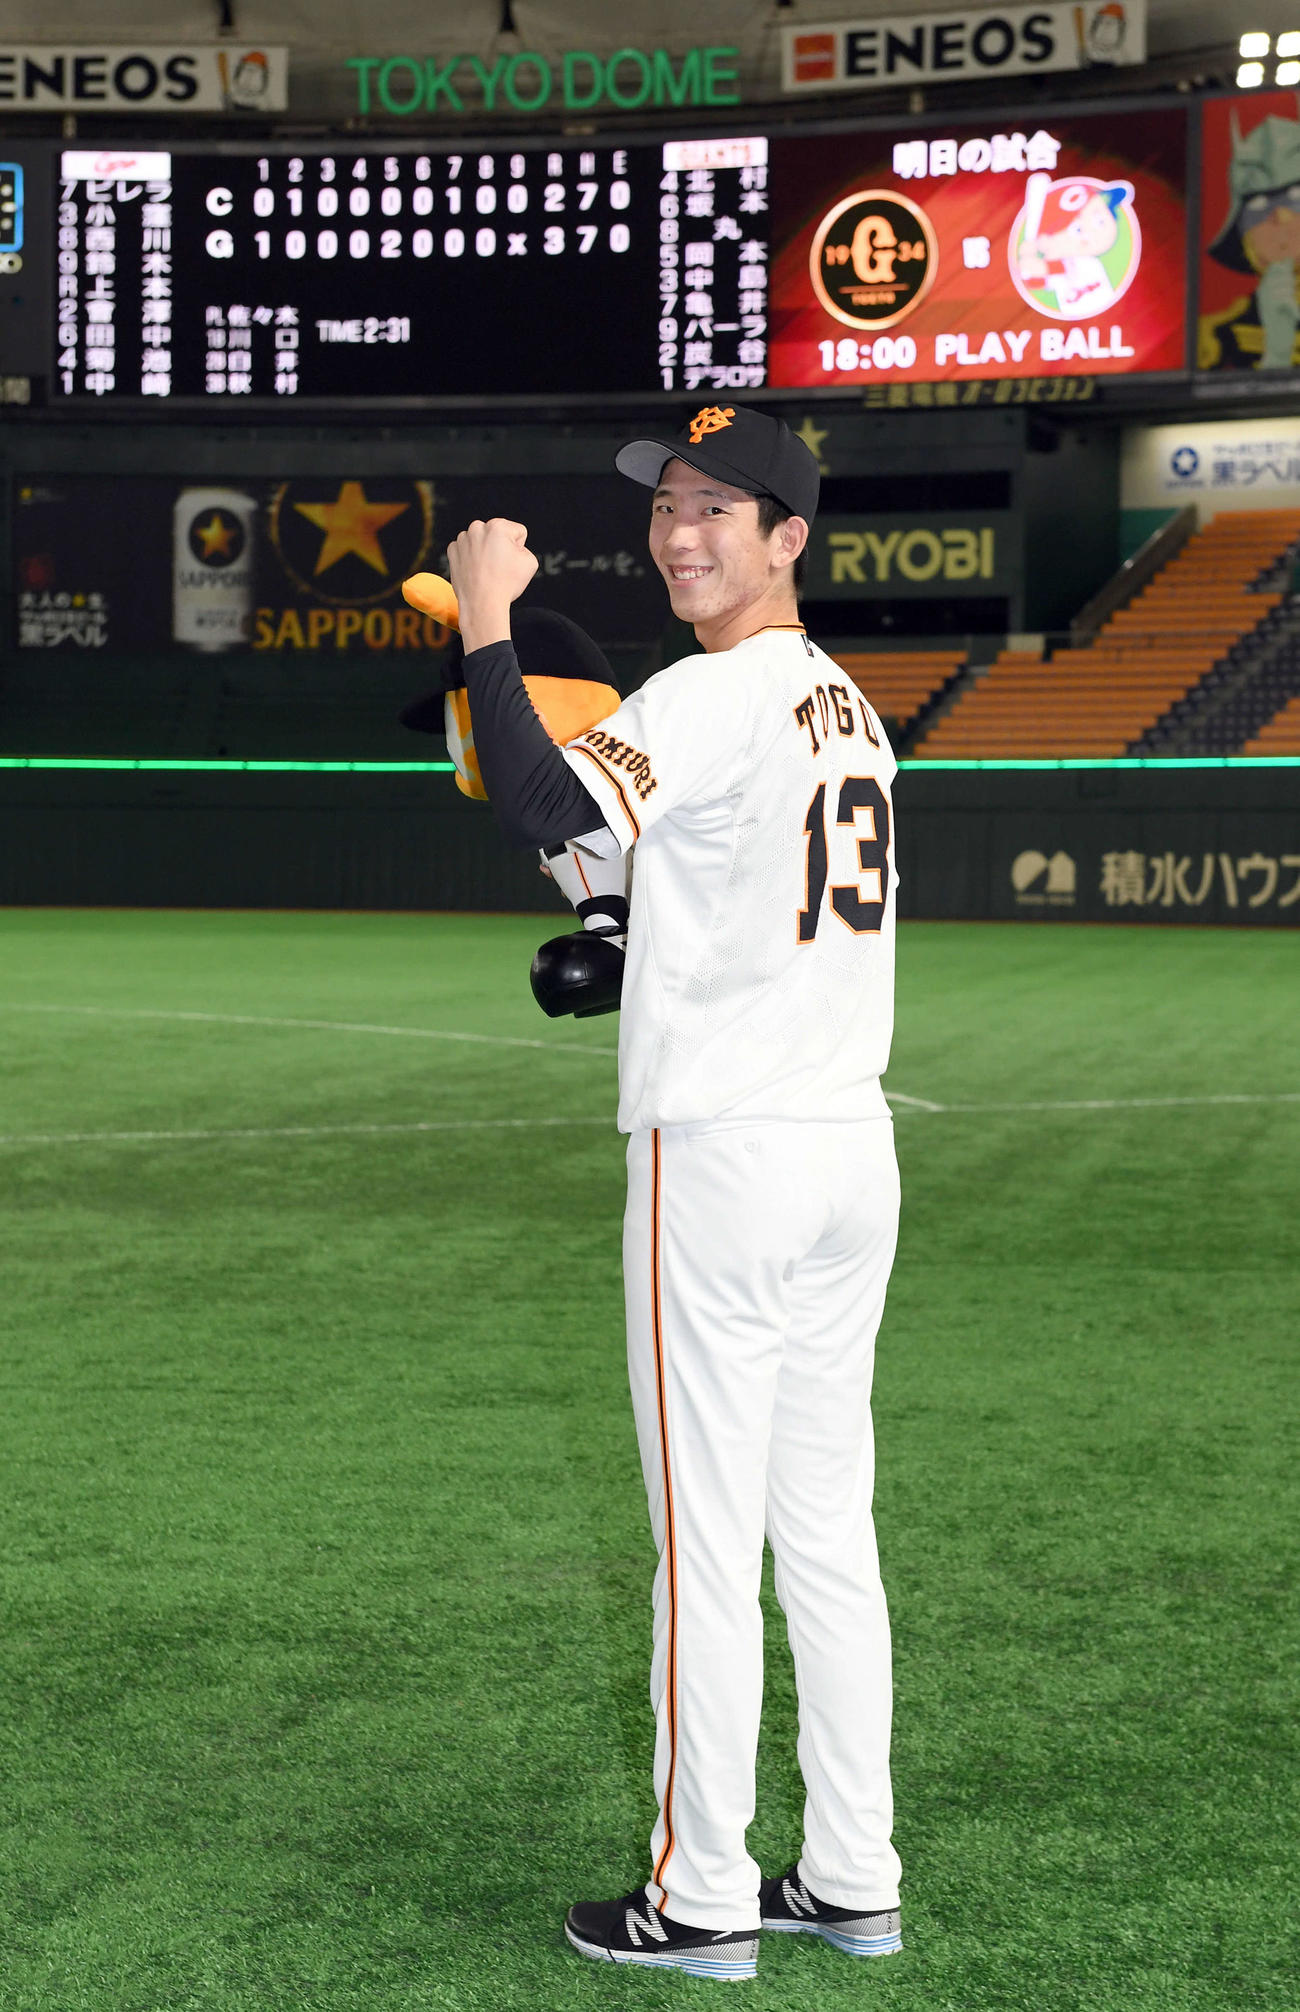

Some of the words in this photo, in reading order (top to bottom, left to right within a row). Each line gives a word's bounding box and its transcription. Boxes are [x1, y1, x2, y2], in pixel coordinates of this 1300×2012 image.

[845, 14, 1055, 78] ENEOS
[345, 52, 552, 115] TOKYO
[562, 46, 741, 108] DOME
[258, 158, 269, 182] 1
[288, 158, 304, 182] 2
[320, 158, 336, 182] 3
[352, 158, 368, 181] 4
[384, 157, 400, 181] 5
[416, 156, 431, 180] 6
[447, 156, 463, 180] 7
[612, 150, 628, 175] E
[893, 130, 1061, 179] 明日の試合
[60, 179, 78, 201] 7
[659, 171, 679, 193] 4
[206, 187, 233, 217] C
[254, 187, 275, 217] 0
[287, 188, 303, 217] 1
[317, 187, 339, 217] 0
[349, 187, 370, 217] 0
[381, 186, 402, 216] 0
[413, 186, 434, 216] 0
[445, 186, 461, 215] 1
[476, 185, 497, 215] 0
[507, 184, 528, 214] 0
[544, 183, 566, 212] 2
[576, 182, 598, 211] 7
[609, 181, 631, 210] 0
[660, 194, 680, 219] 6
[59, 201, 78, 226] 3
[255, 230, 271, 259] 1
[285, 230, 307, 260] 0
[317, 229, 339, 260] 0
[349, 229, 370, 259] 0
[381, 229, 402, 259] 2
[413, 229, 434, 259] 0
[445, 228, 465, 258] 0
[476, 227, 497, 257] 0
[544, 225, 566, 255] 3
[576, 225, 598, 254] 7
[609, 223, 631, 253] 0
[852, 215, 898, 284] G
[660, 244, 679, 268] 5
[659, 268, 678, 292] 3
[59, 298, 78, 322] 2
[660, 293, 678, 316] 7
[58, 322, 78, 347] 6
[316, 320, 363, 343] TIME
[363, 316, 411, 344] 2:31
[58, 347, 77, 370] 4
[659, 342, 677, 366] 2
[819, 336, 917, 371] 18:00
[935, 330, 1031, 365] PLAY
[1040, 325, 1135, 361] BALL
[61, 370, 74, 394] 1
[661, 367, 674, 390] 1
[828, 528, 995, 582] RYOBI
[252, 607, 451, 650] SAPPORO
[572, 730, 658, 801] OMIURI
[797, 775, 890, 945] 13
[625, 1902, 669, 1946] N
